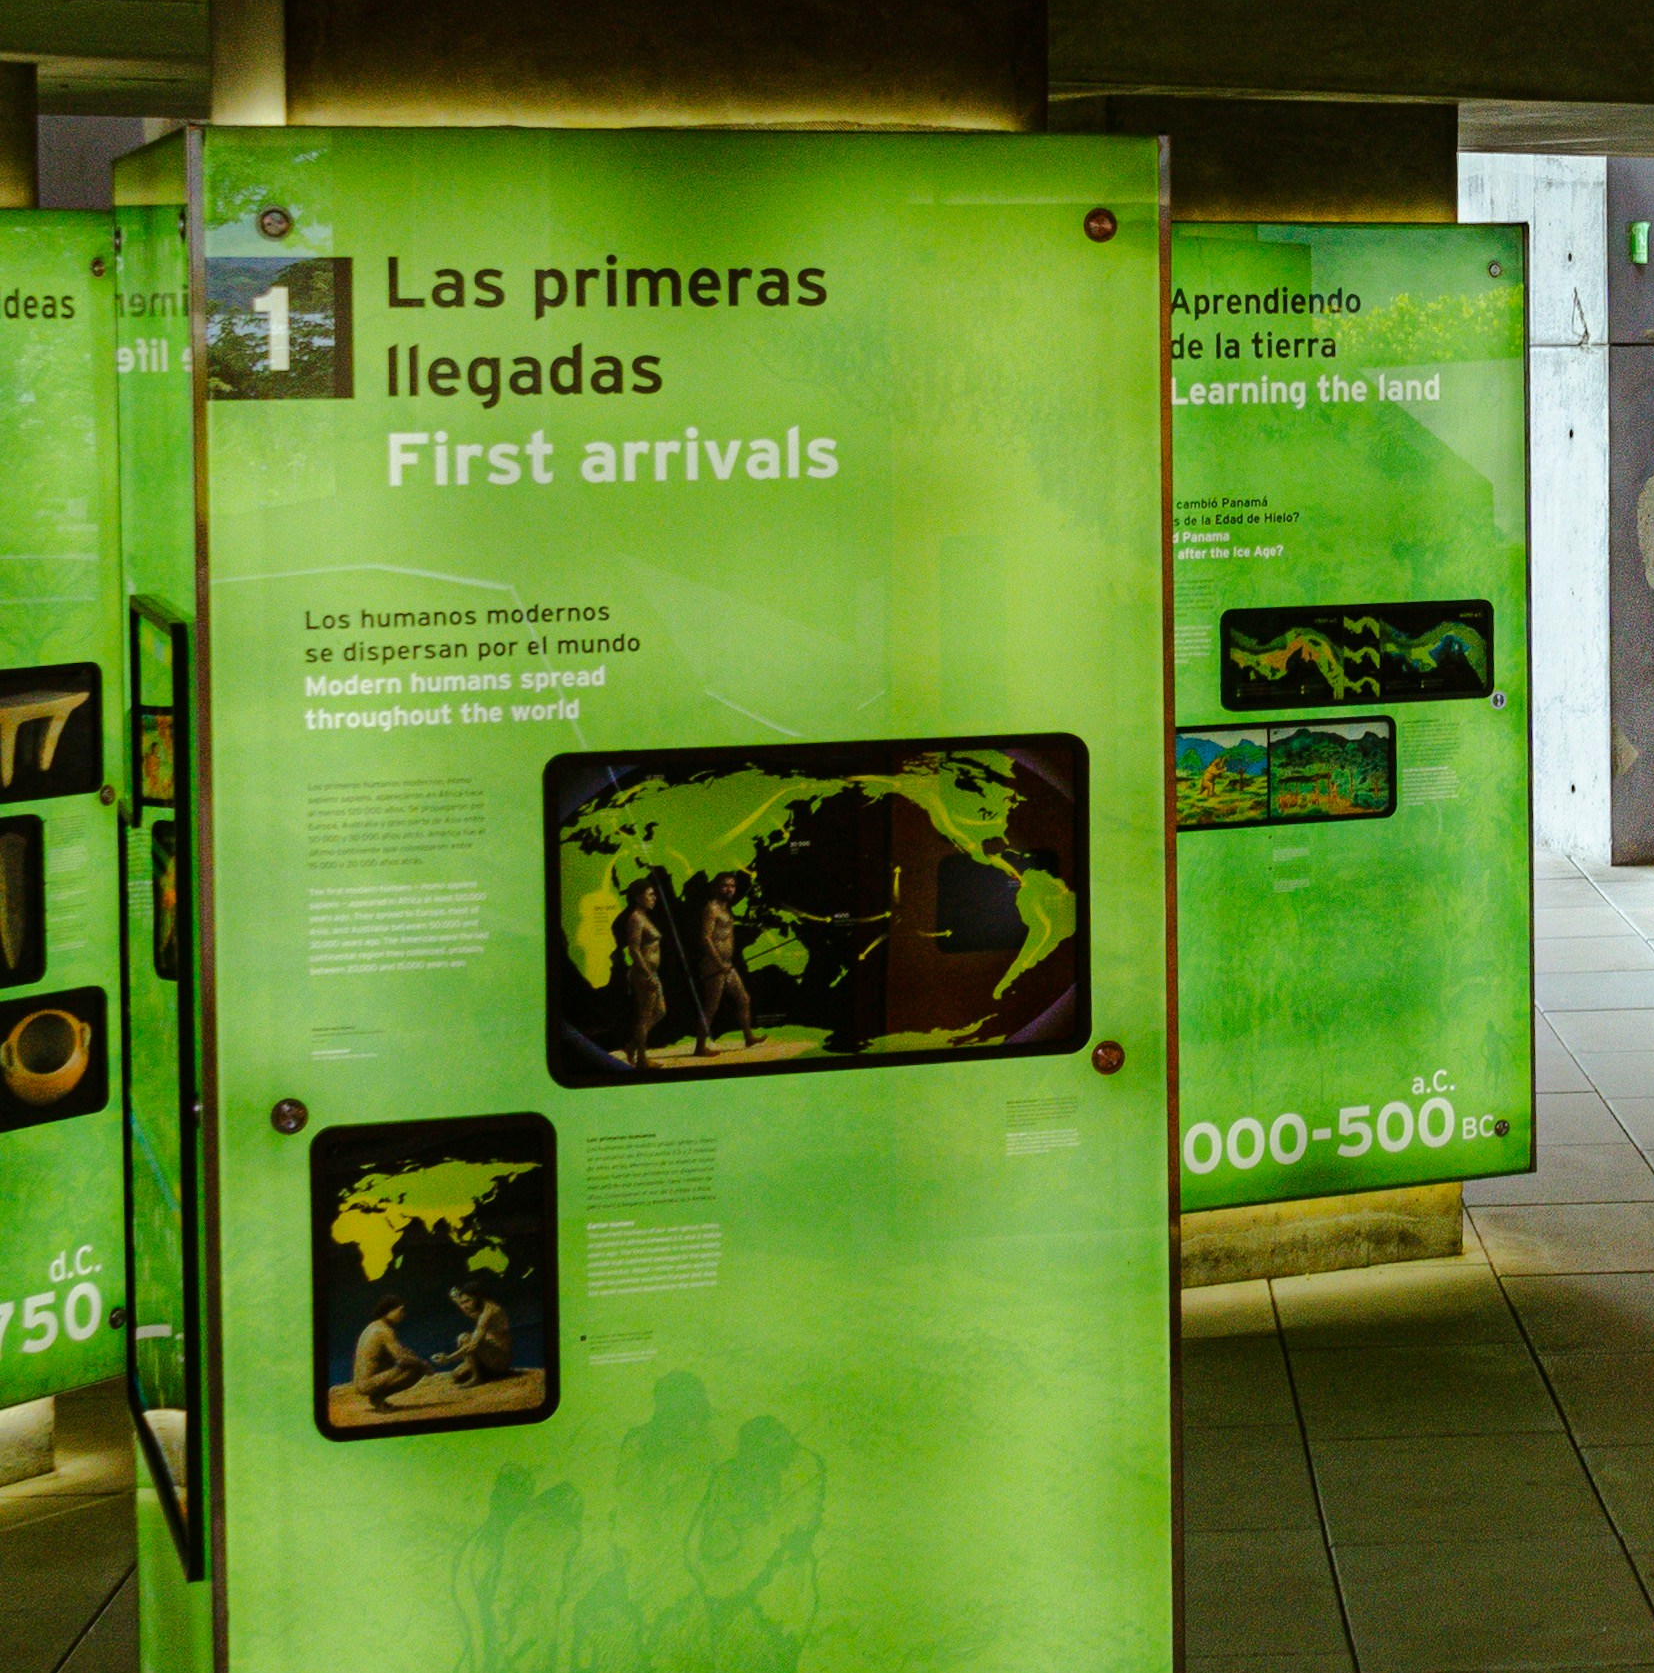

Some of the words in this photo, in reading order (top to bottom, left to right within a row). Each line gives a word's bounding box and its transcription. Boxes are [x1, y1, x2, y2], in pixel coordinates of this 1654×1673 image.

[388, 256, 504, 308] Las
[535, 255, 826, 319] primeras
[1170, 287, 1362, 321] Aprendiendo
[253, 286, 290, 371] 1
[1170, 334, 1203, 361] de
[1215, 333, 1241, 360] la
[1251, 331, 1336, 359] tierra
[388, 343, 662, 409] llegadas
[1170, 375, 1306, 409] Learning
[1317, 375, 1367, 402] the
[1378, 373, 1440, 402] land
[388, 430, 553, 487] First
[581, 426, 838, 483] arrivals
[1176, 498, 1218, 509] cambió
[1221, 496, 1268, 508] Panamá
[1184, 515, 1197, 526] de
[1201, 515, 1211, 526] la
[1215, 513, 1244, 525] Edad
[1246, 513, 1260, 524] de
[1264, 511, 1300, 523] Hielo?
[1177, 547, 1207, 560] after
[1209, 546, 1230, 559] the
[1232, 546, 1251, 558] Ice
[1253, 544, 1284, 559] Age?
[1182, 531, 1230, 543] Panama
[305, 610, 350, 630] Los
[361, 606, 477, 628] humanos
[487, 604, 610, 624] modernos
[305, 647, 332, 663] se
[344, 642, 468, 665] dispersan
[479, 641, 518, 661] por
[527, 636, 547, 655] el
[558, 634, 640, 654] mundo
[305, 674, 401, 697] Modern
[409, 672, 511, 693] humans
[520, 665, 606, 692] spread
[304, 704, 451, 732] throughout
[459, 703, 503, 724] the
[511, 698, 579, 721] world
[1412, 1069, 1456, 1095] a.C.
[1183, 1096, 1455, 1174] 000-500
[1461, 1115, 1496, 1140] BC
[49, 1245, 102, 1282] d.C.
